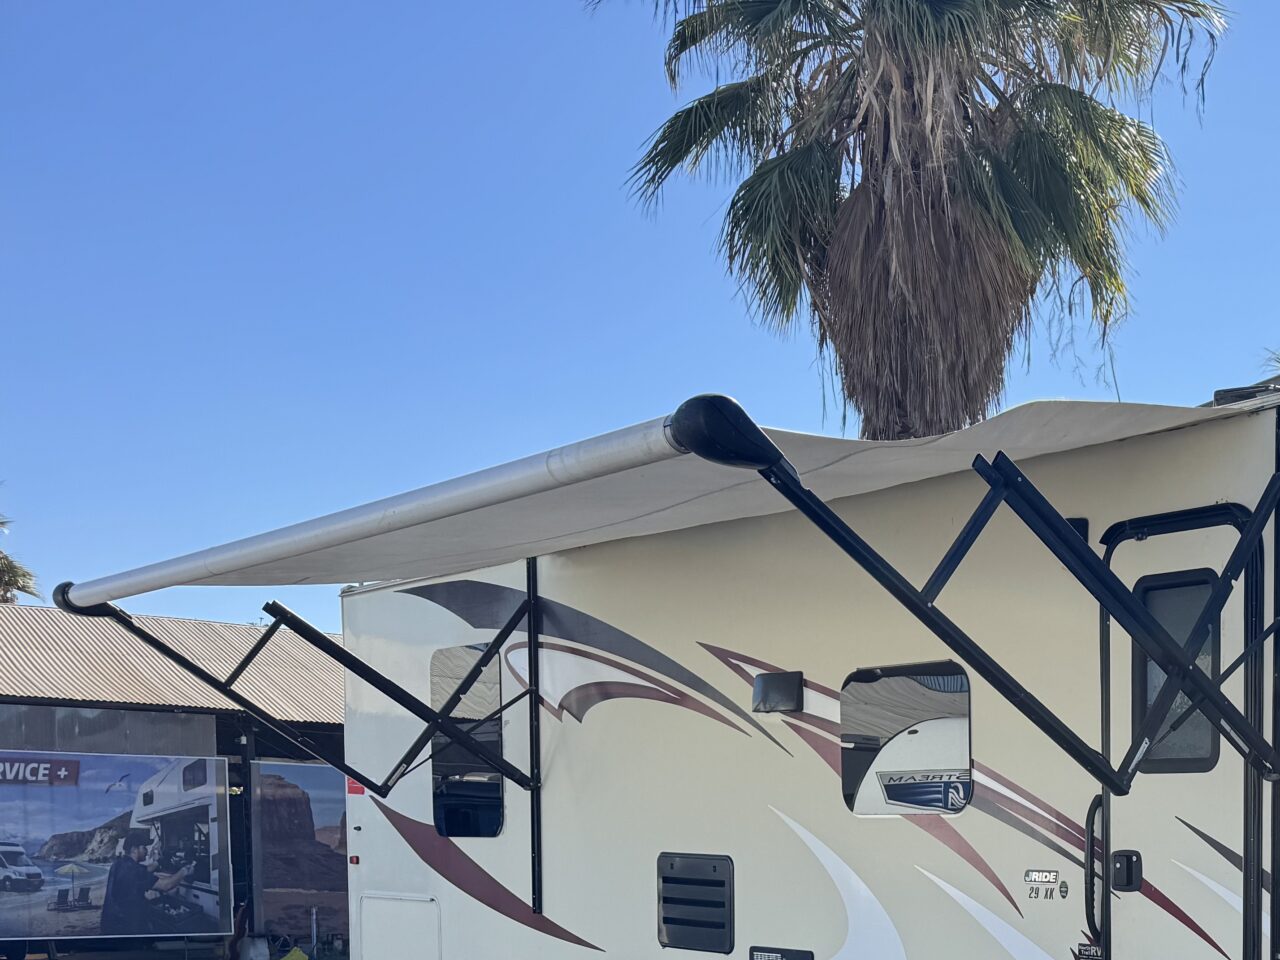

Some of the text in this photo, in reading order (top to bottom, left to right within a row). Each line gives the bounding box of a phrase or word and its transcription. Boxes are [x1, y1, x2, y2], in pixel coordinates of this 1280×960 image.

[1028, 886, 1040, 899] 29
[1043, 887, 1055, 900] XK
[1091, 946, 1102, 957] RV
